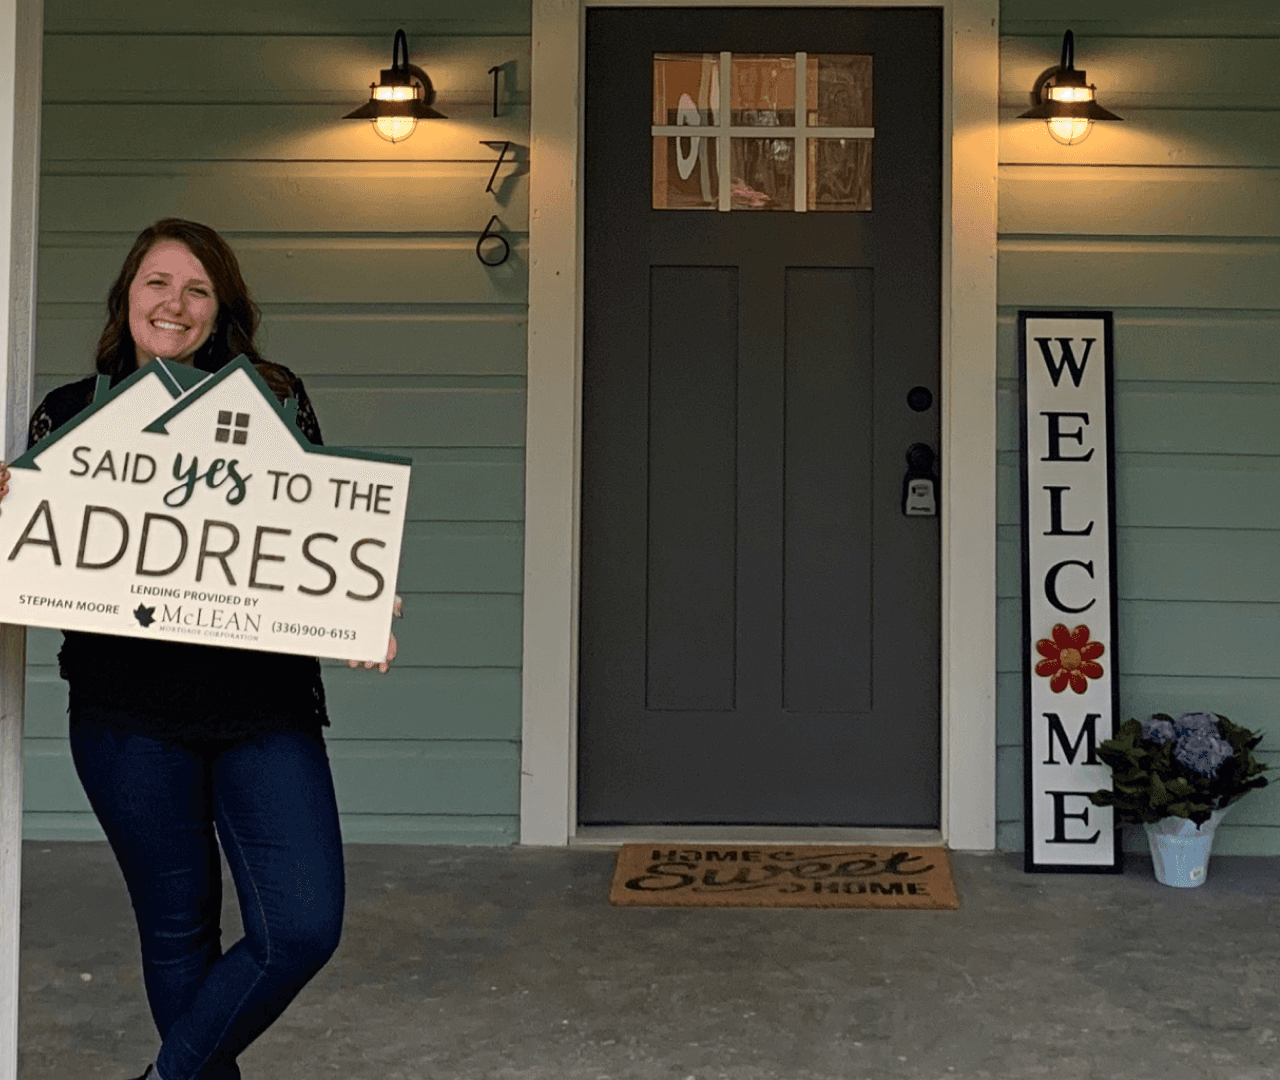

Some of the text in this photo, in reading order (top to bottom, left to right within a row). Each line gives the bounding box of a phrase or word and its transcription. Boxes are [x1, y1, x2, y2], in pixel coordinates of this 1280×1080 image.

[69, 446, 394, 514] SAID yes TO THE
[7, 499, 388, 602] ADDRESS
[130, 584, 259, 607] LENDING PROVIDED BY
[1033, 336, 1104, 845] WELCME
[19, 594, 120, 615] STEPHAN MOORE
[161, 604, 262, 632] McLEAN
[204, 630, 259, 641] CORPORATION
[651, 850, 762, 862] HOME
[624, 851, 935, 892] Sweet
[812, 881, 930, 896] HOME
